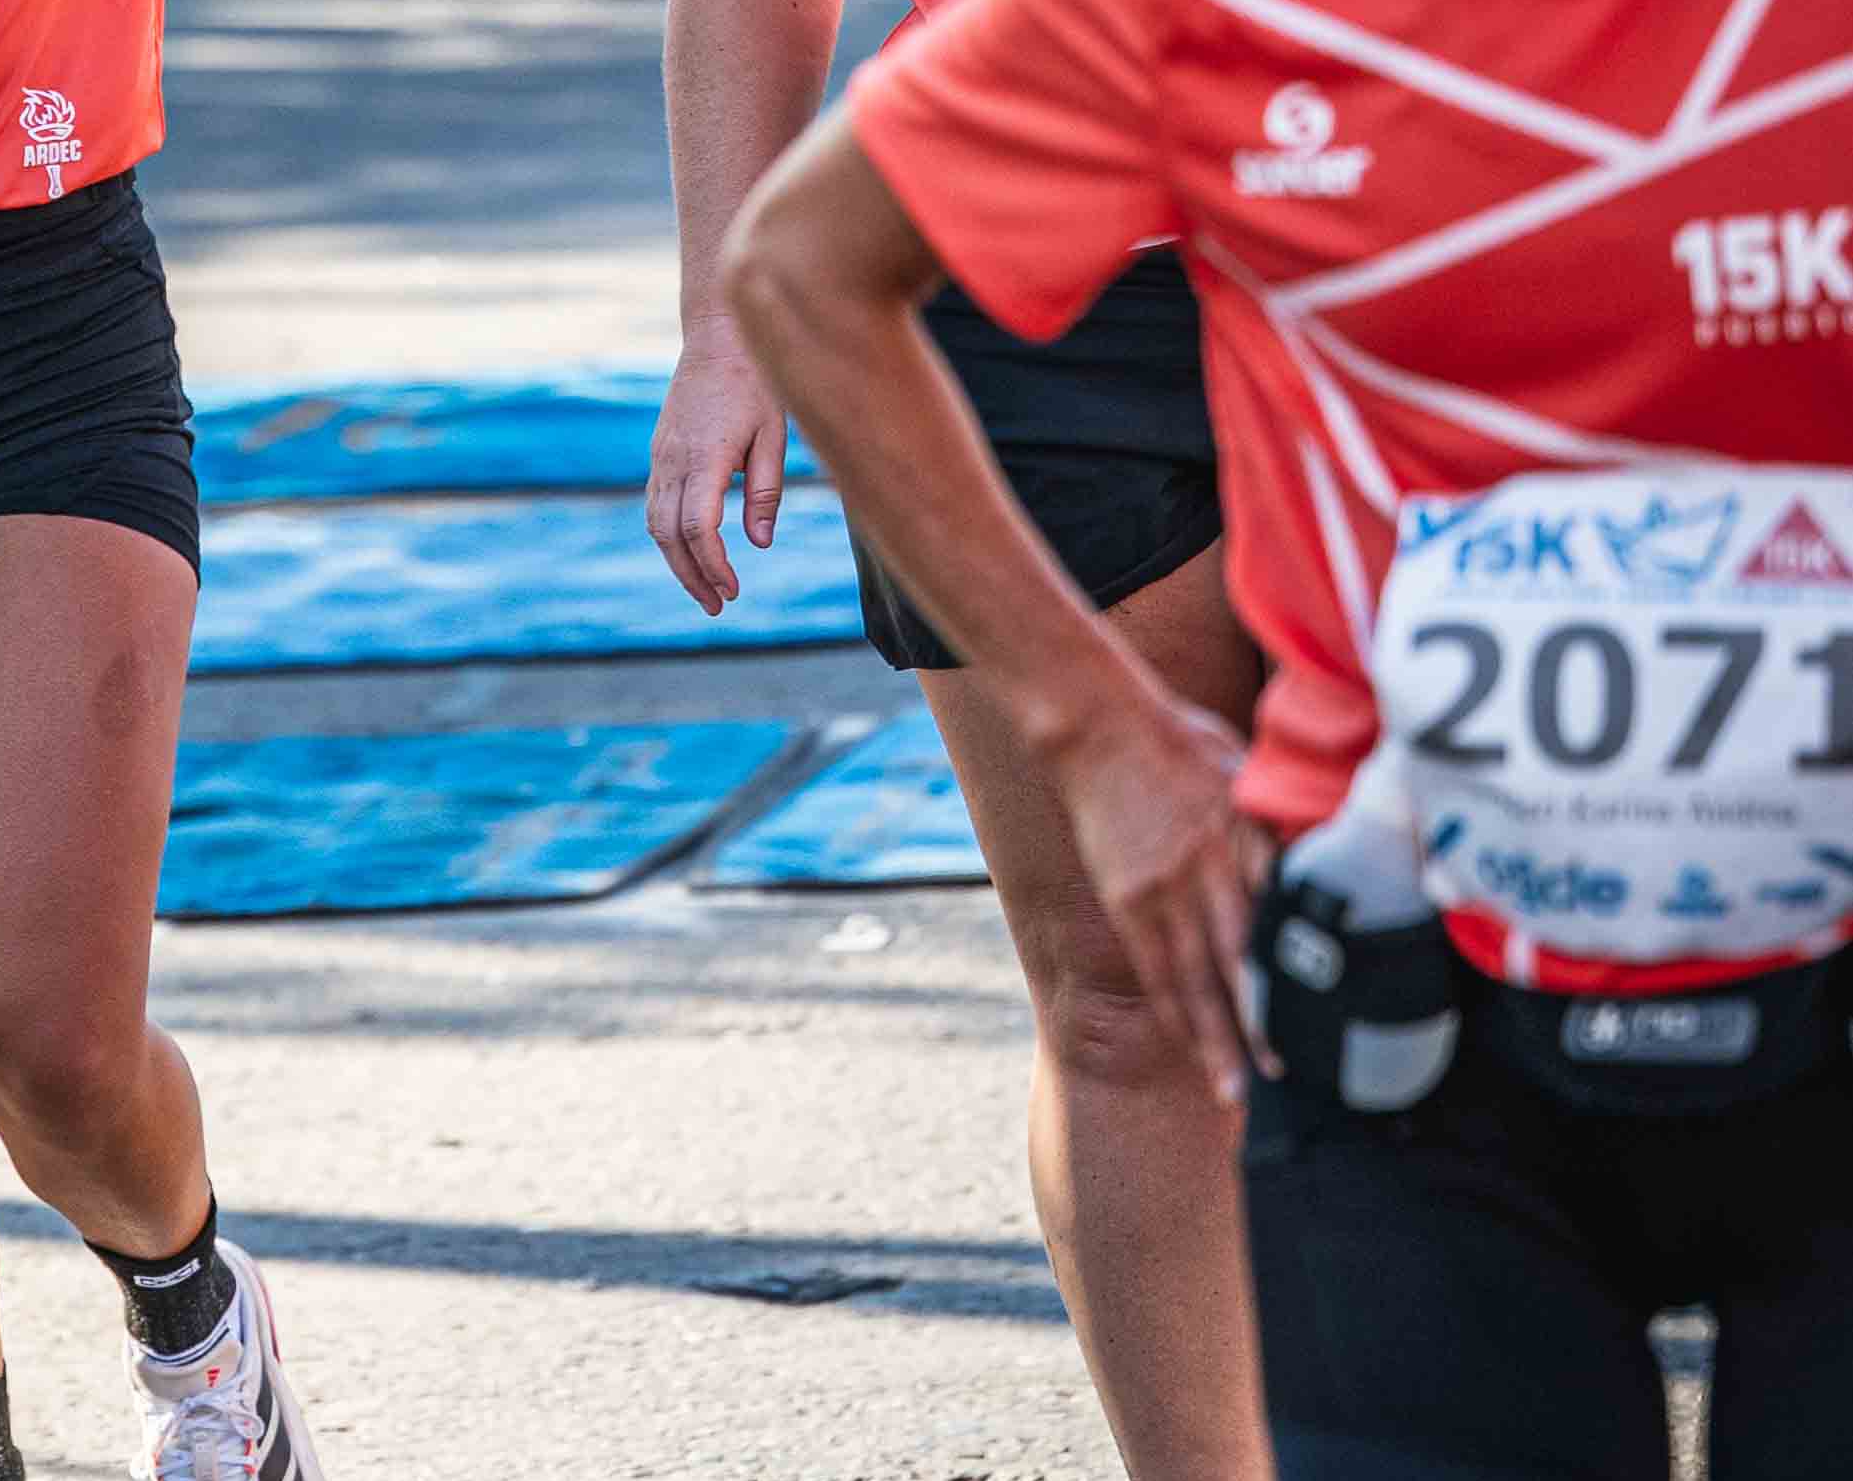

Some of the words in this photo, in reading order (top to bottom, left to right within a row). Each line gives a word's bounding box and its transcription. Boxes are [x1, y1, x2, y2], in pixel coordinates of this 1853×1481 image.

[23, 139, 83, 168] ARDEC
[1670, 206, 1853, 316] 15K
[1410, 620, 1853, 774] 2071
